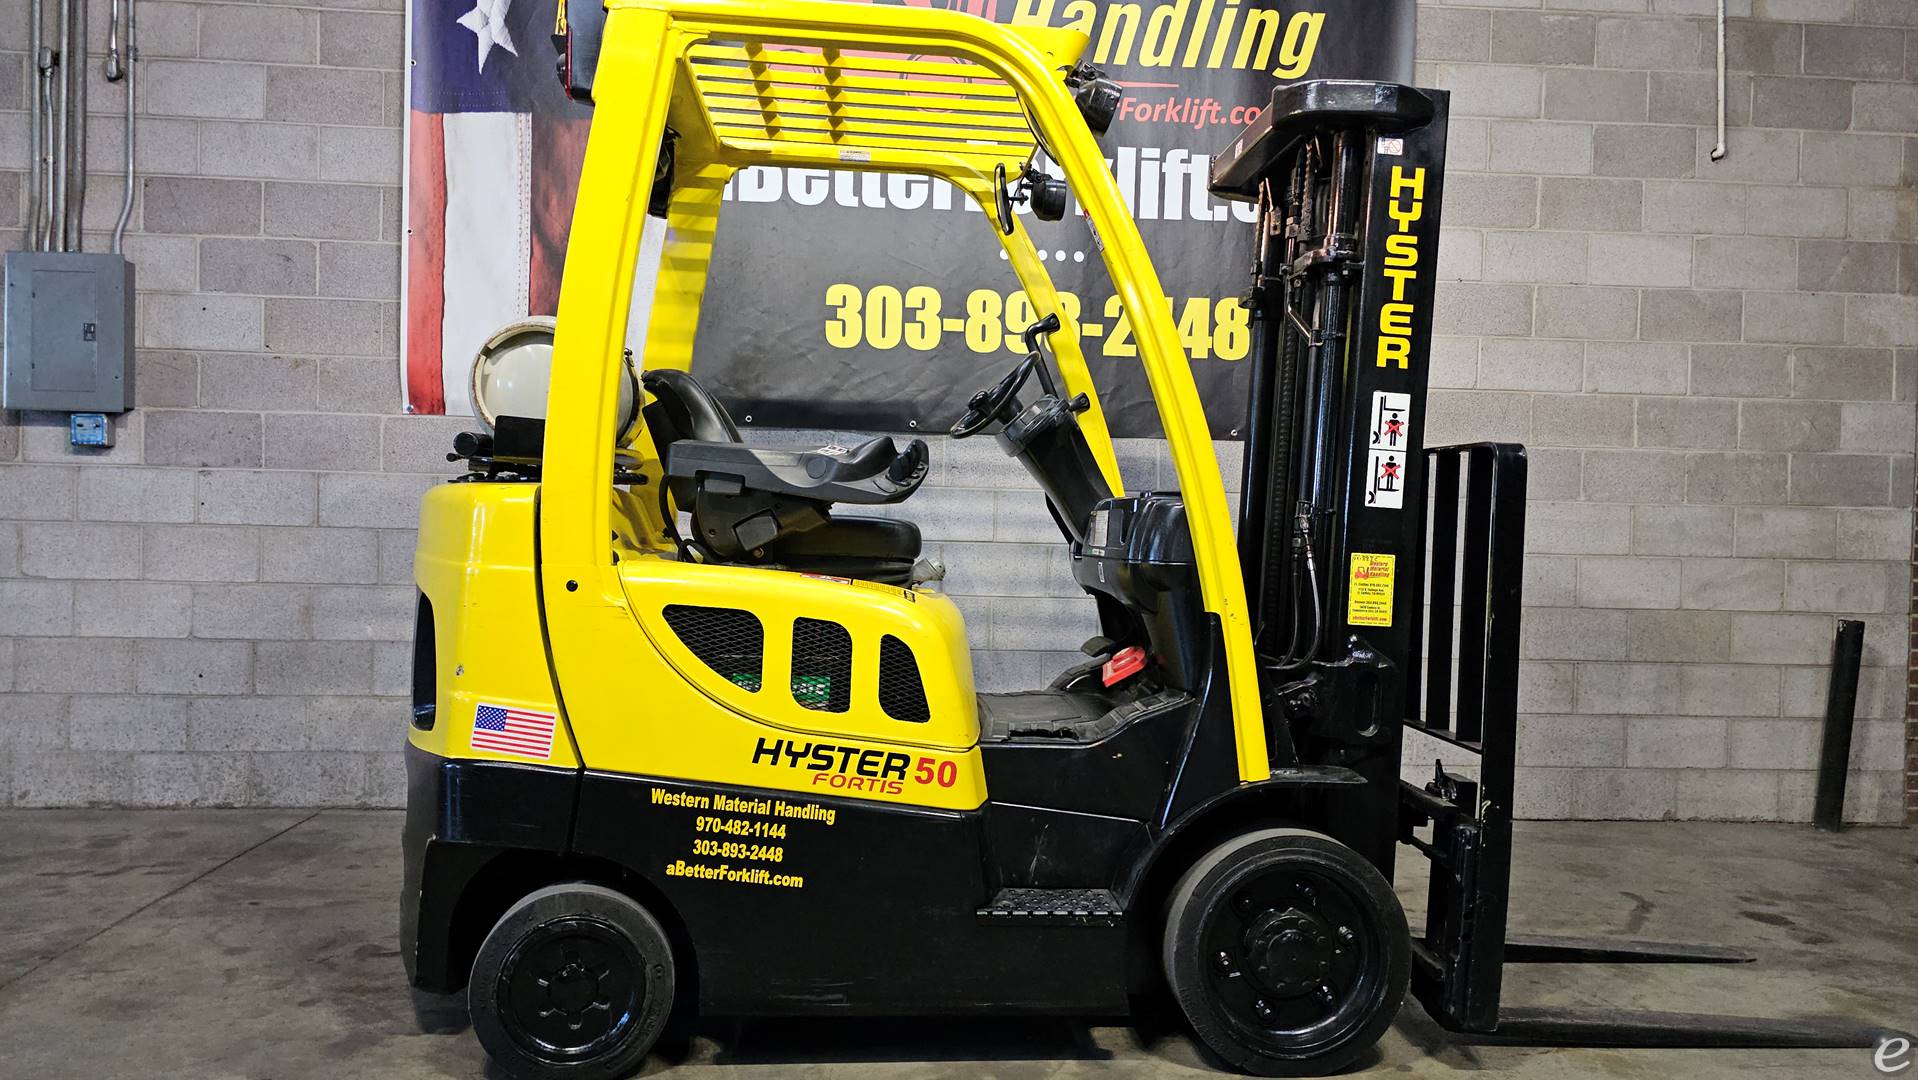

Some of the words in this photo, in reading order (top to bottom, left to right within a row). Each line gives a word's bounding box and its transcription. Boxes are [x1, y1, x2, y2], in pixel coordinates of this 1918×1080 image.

[1117, 97, 1262, 129] Forklift.co
[1376, 165, 1425, 369] HYSTER
[825, 283, 1250, 361] 303-89-248
[752, 737, 911, 781] HYSTER
[914, 757, 958, 788] 50
[812, 773, 904, 795] FORTIS
[651, 788, 710, 809] Western
[713, 794, 771, 815] Material
[774, 800, 836, 825] Handling
[696, 816, 787, 839] 970-482-1144
[692, 839, 784, 862] 303-893-2448
[665, 860, 804, 887] aBetterForklift.com
